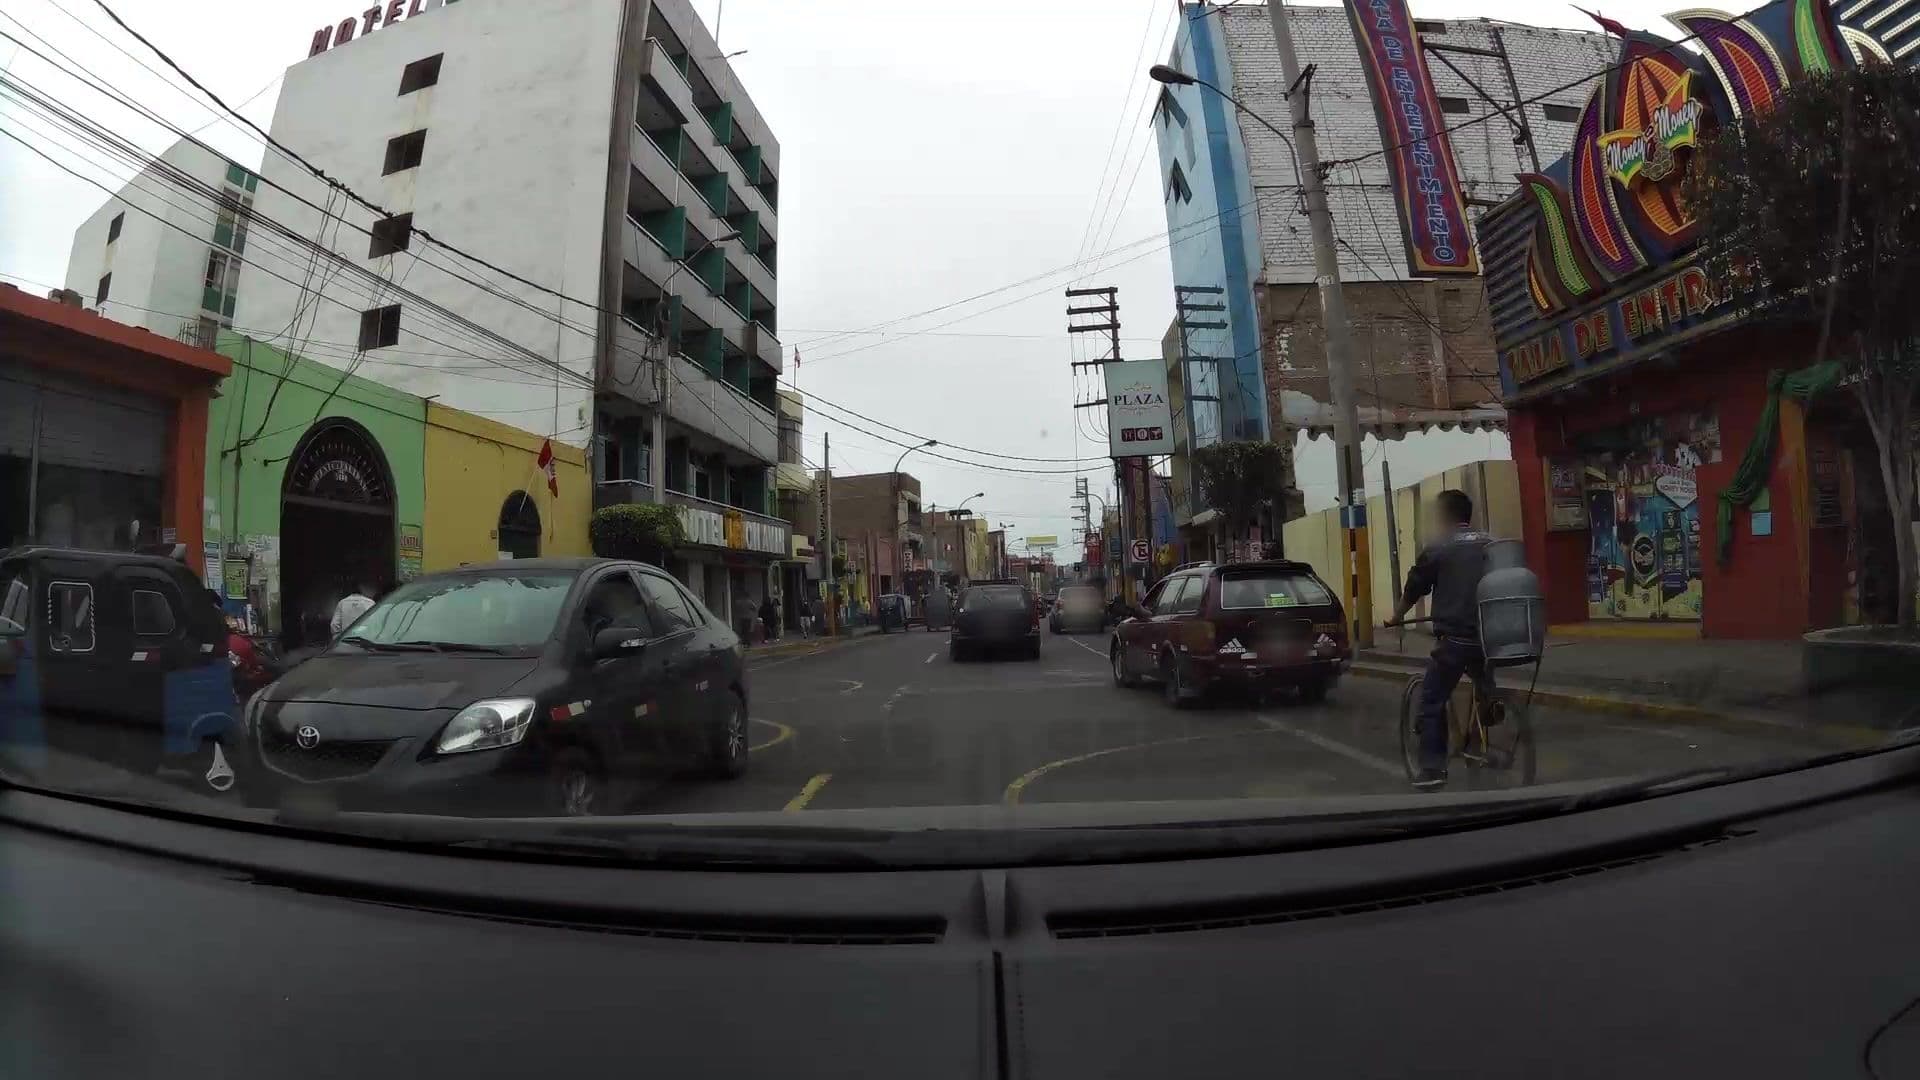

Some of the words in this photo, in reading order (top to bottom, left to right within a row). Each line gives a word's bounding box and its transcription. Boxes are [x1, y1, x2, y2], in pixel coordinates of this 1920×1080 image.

[308, 0, 425, 58] HOTEL
[1381, 35, 1405, 60] DE
[1654, 102, 1696, 138] Money
[1392, 67, 1456, 263] ENTRETENIMIENTO
[1607, 136, 1646, 172] Money
[1573, 309, 1612, 358] DE
[1114, 394, 1164, 405] PLAZA
